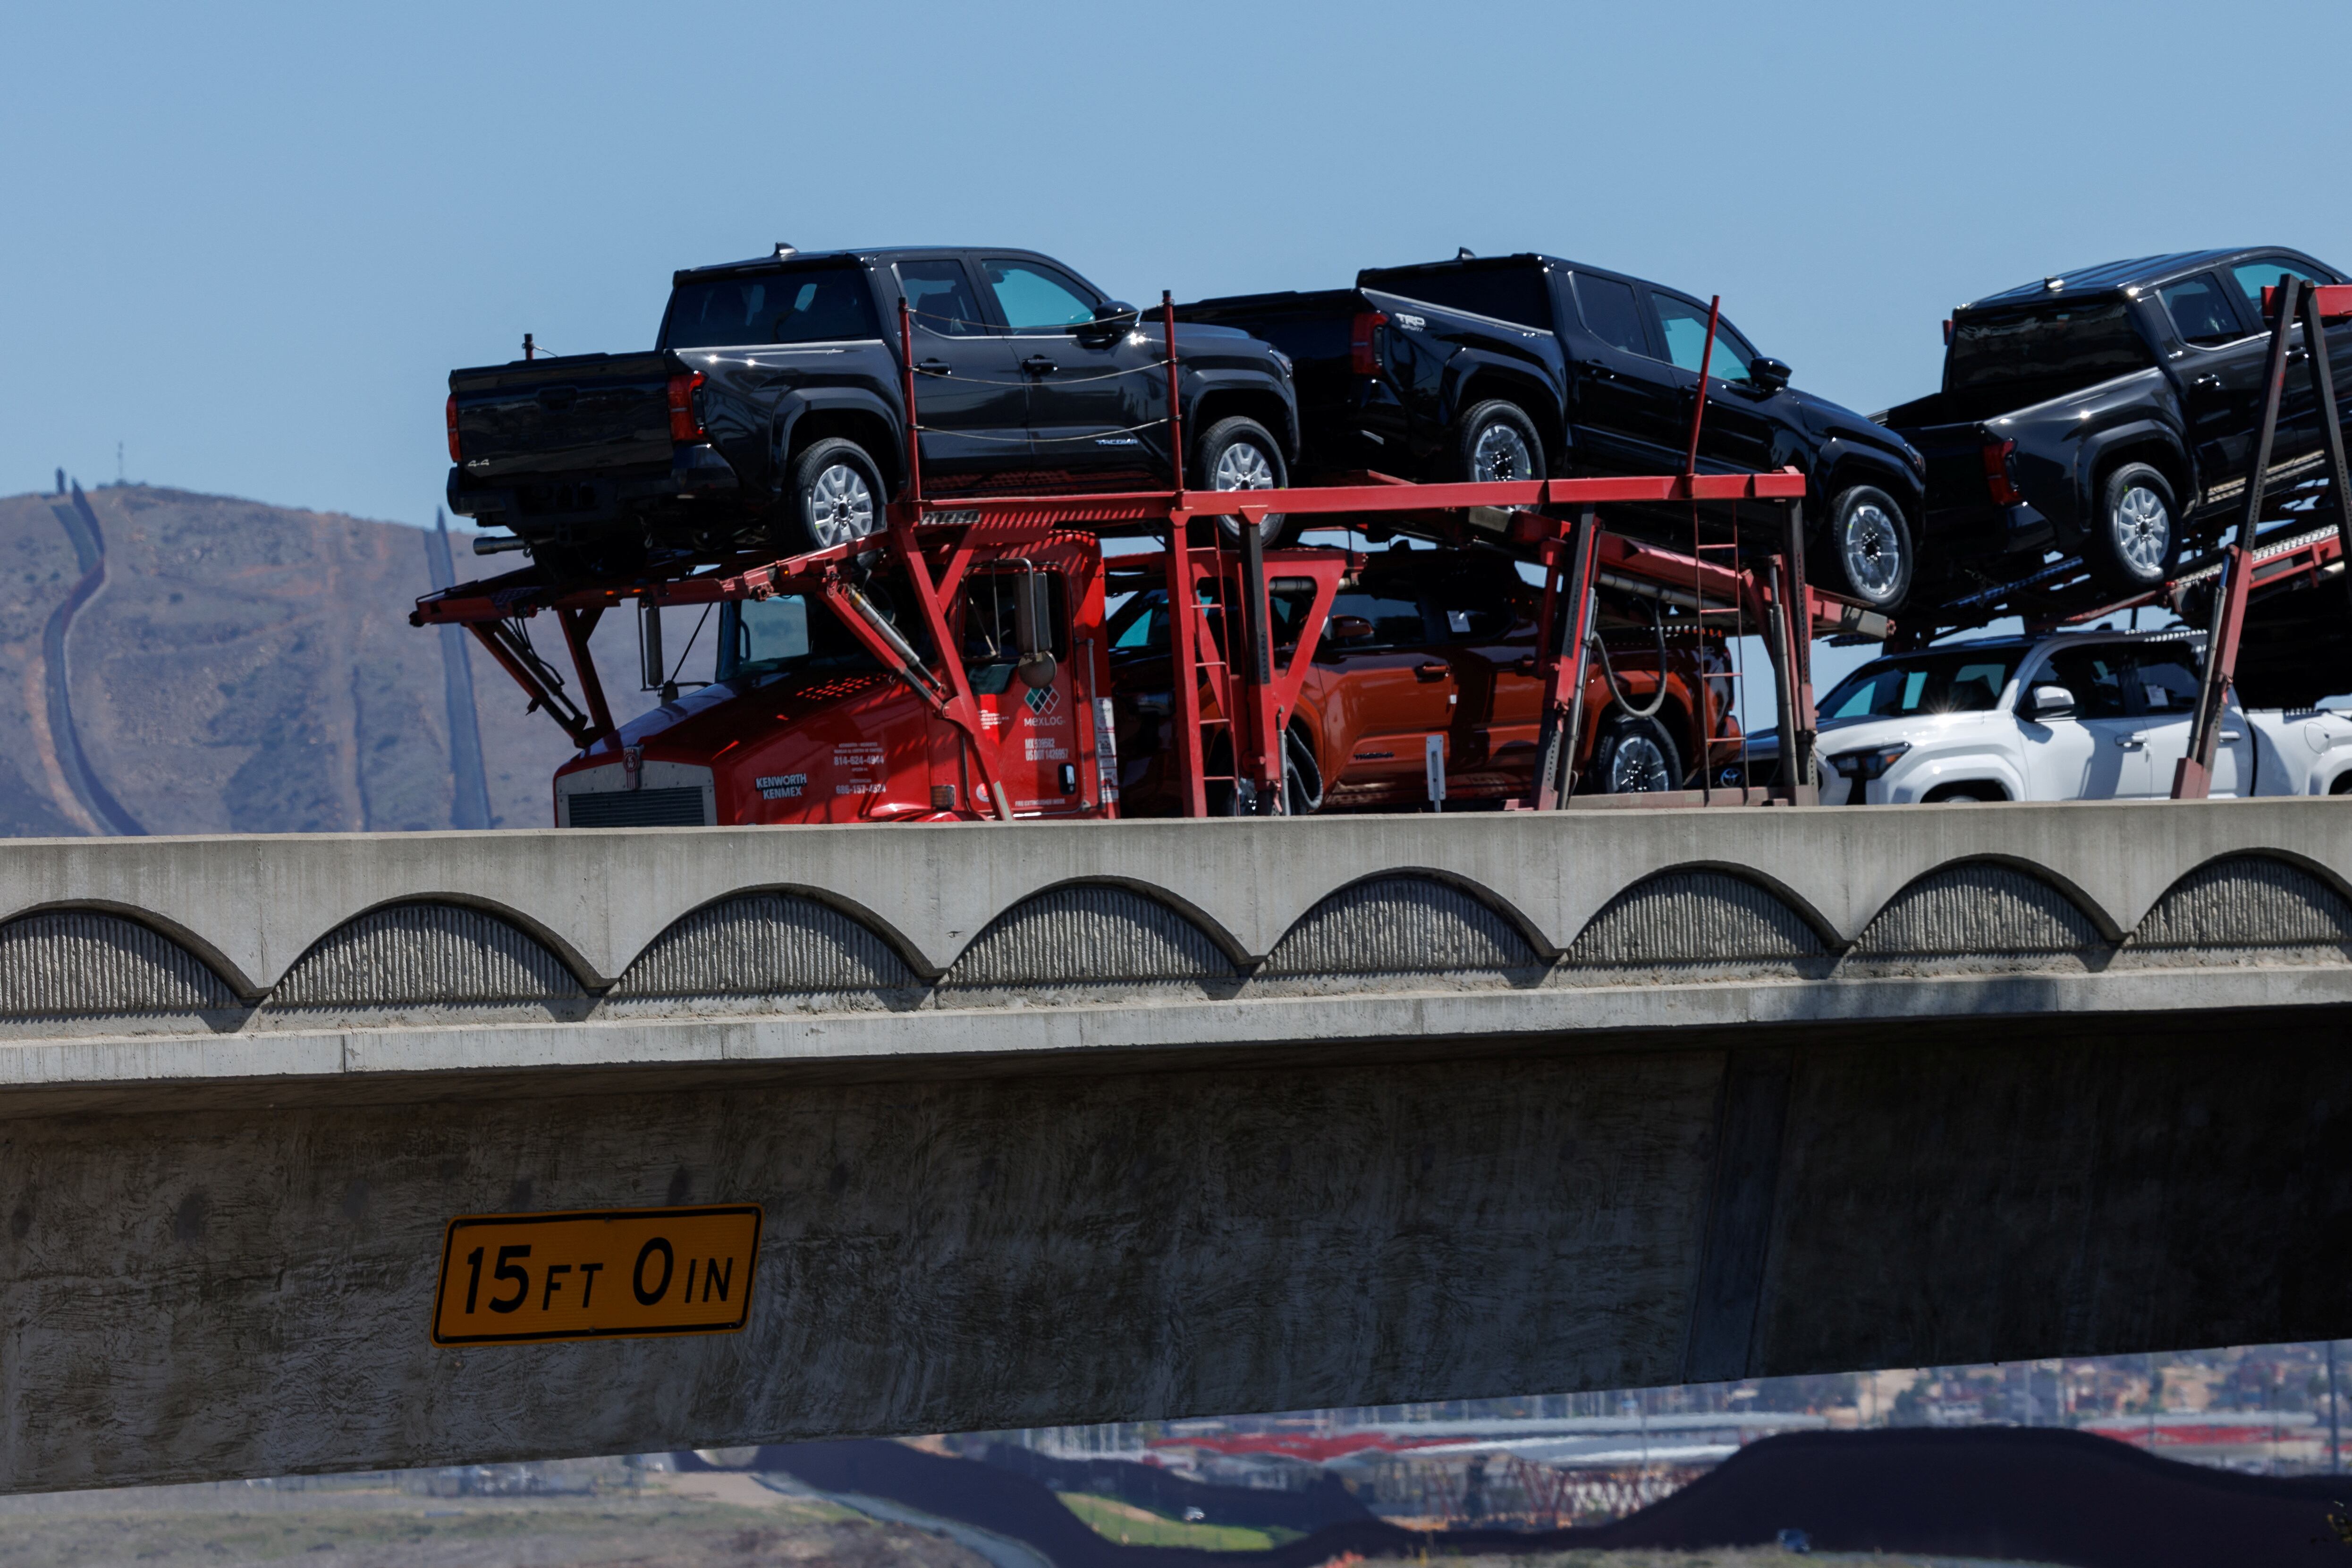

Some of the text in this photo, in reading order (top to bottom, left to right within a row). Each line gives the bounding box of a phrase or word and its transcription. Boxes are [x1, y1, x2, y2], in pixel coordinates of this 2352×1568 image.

[1395, 313, 1425, 327] TRD
[755, 773, 807, 788] KENWORTH
[762, 786, 803, 800] KENMEX
[465, 1237, 733, 1314] 15 FT 0 IN
